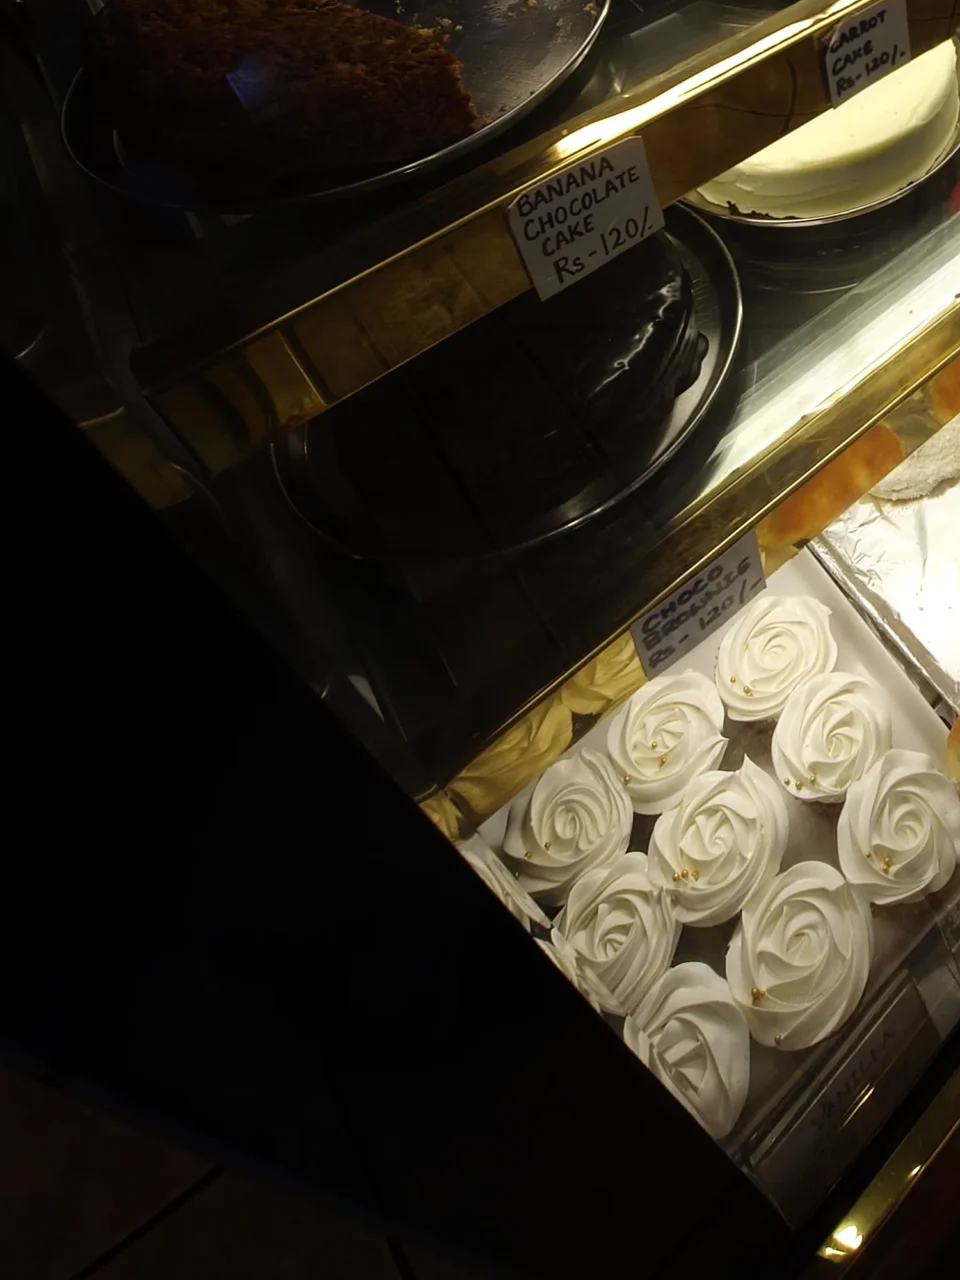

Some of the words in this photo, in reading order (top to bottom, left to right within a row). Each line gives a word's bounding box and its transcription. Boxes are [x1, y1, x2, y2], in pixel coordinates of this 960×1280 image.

[830, 9, 886, 54] CARROT
[832, 40, 873, 77] CAKE
[517, 156, 614, 218] BANANA
[524, 166, 640, 241] CHOCOLATE
[542, 213, 595, 257] CAKE
[642, 565, 724, 635] CHOCO
